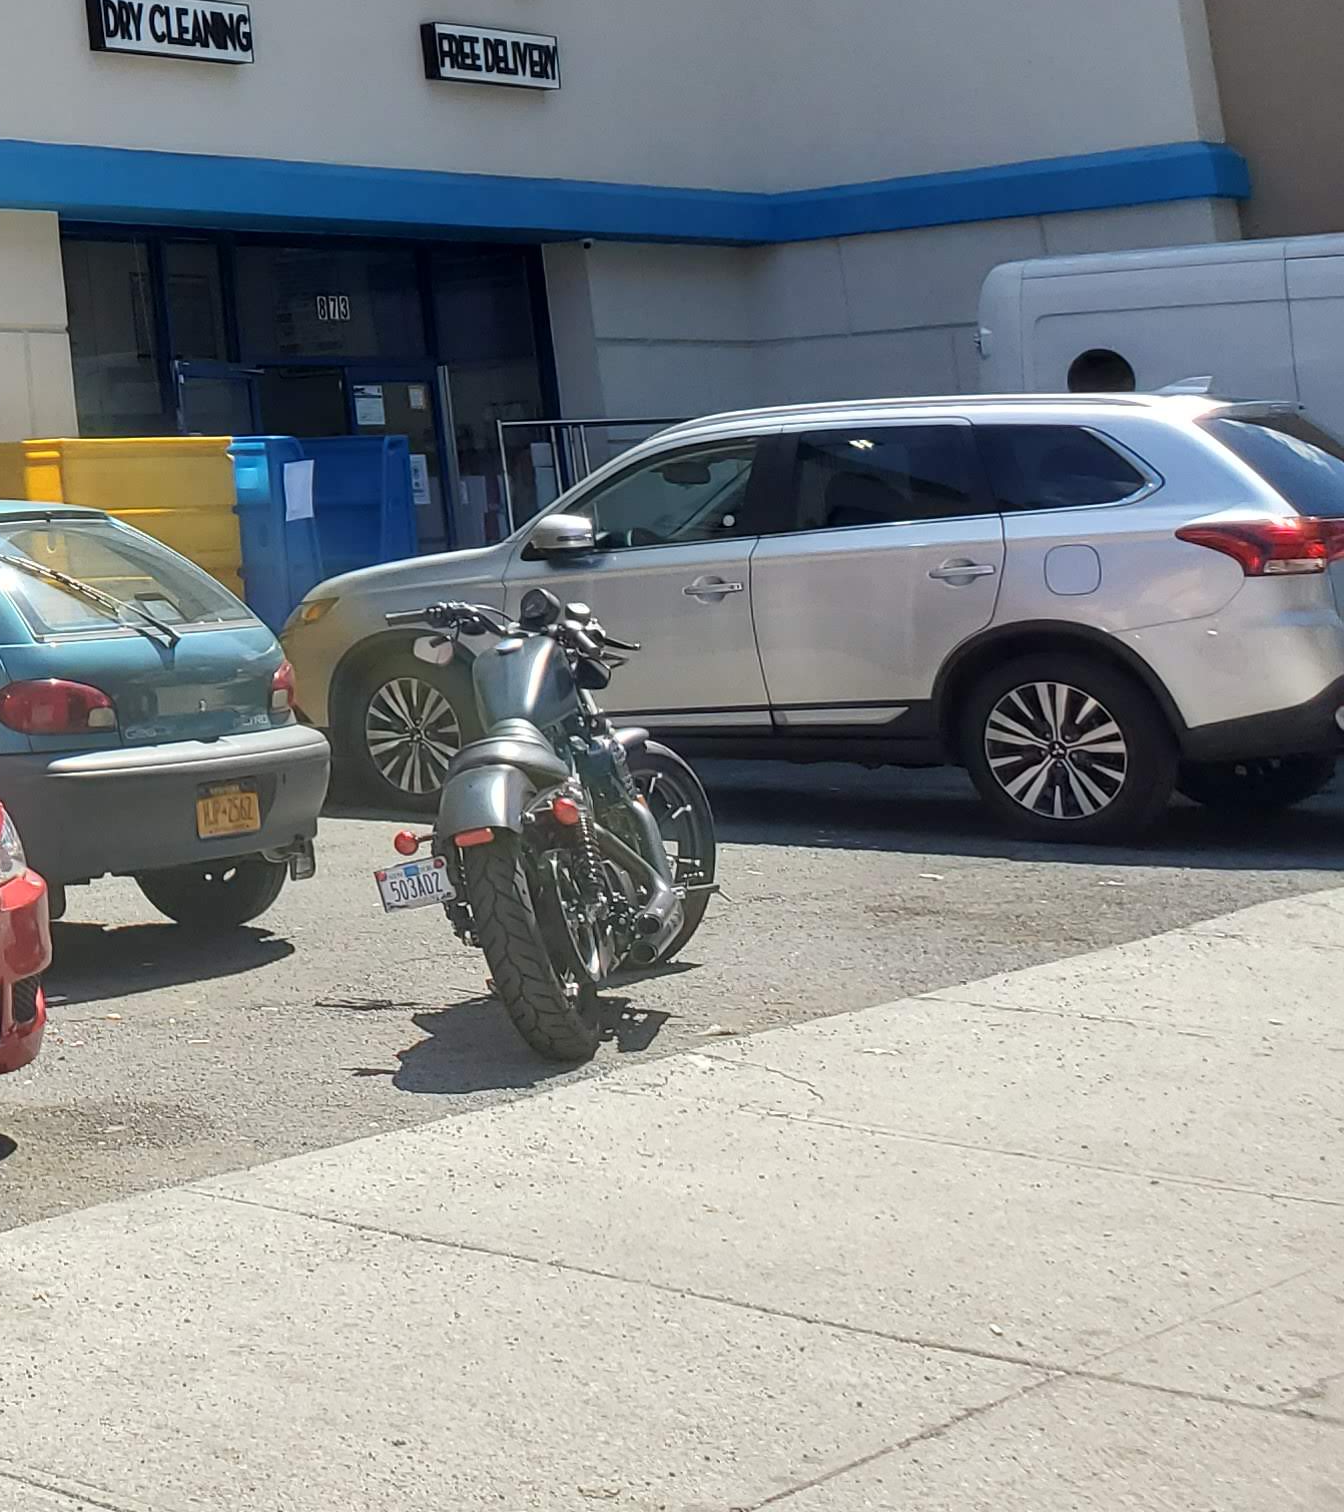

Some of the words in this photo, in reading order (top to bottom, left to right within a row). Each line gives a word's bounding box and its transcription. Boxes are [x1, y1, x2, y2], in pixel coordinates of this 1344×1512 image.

[102, 0, 143, 41] DRY
[438, 32, 482, 71] FREE
[483, 38, 557, 80] DELIVERY
[318, 296, 350, 320] 873
